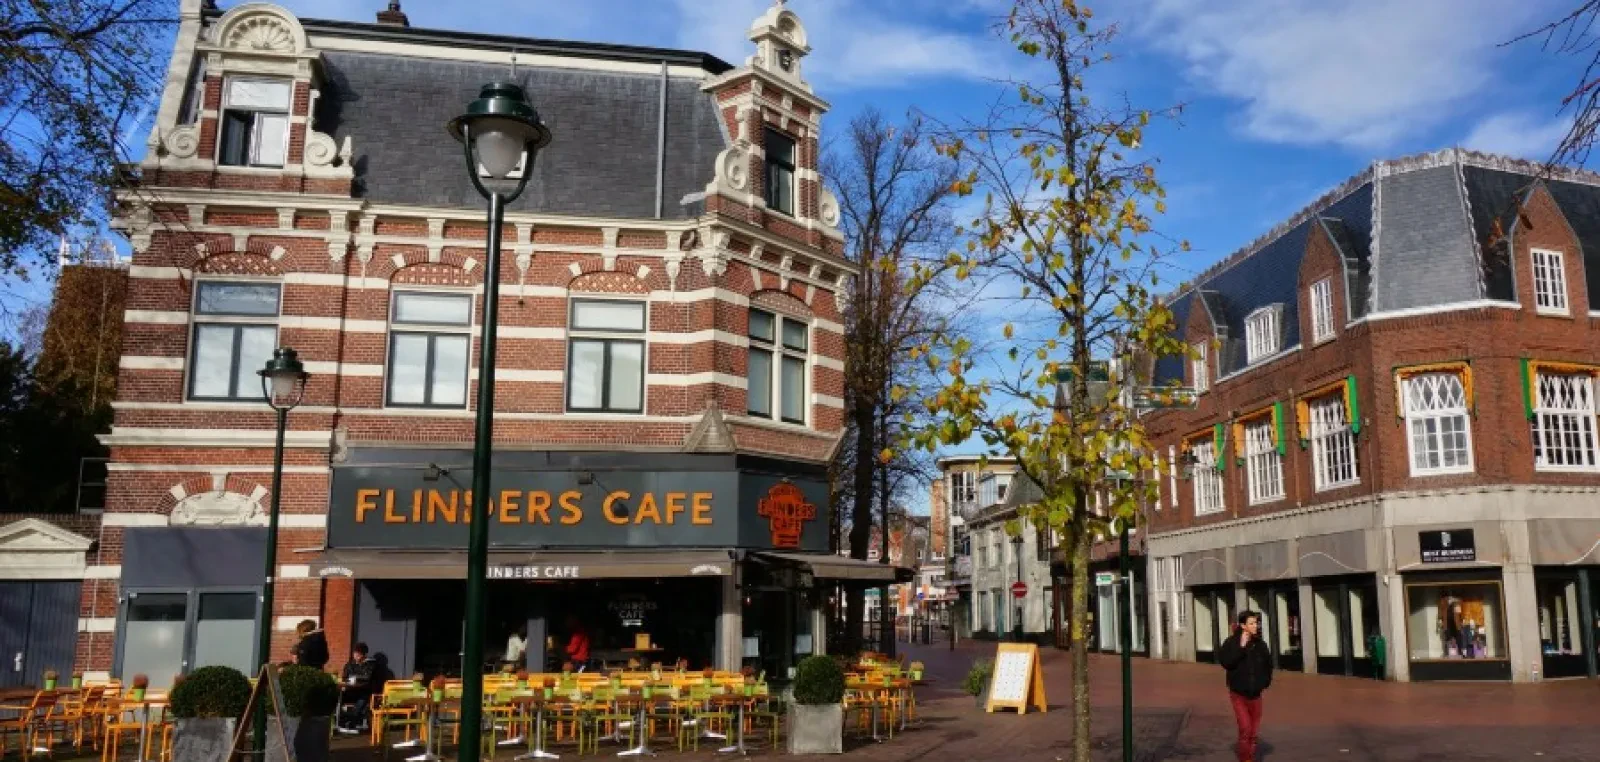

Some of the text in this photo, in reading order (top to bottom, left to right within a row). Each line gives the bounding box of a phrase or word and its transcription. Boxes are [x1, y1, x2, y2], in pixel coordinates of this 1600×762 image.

[602, 490, 714, 526] CAFE
[486, 565, 580, 579] INDERS CAFE
